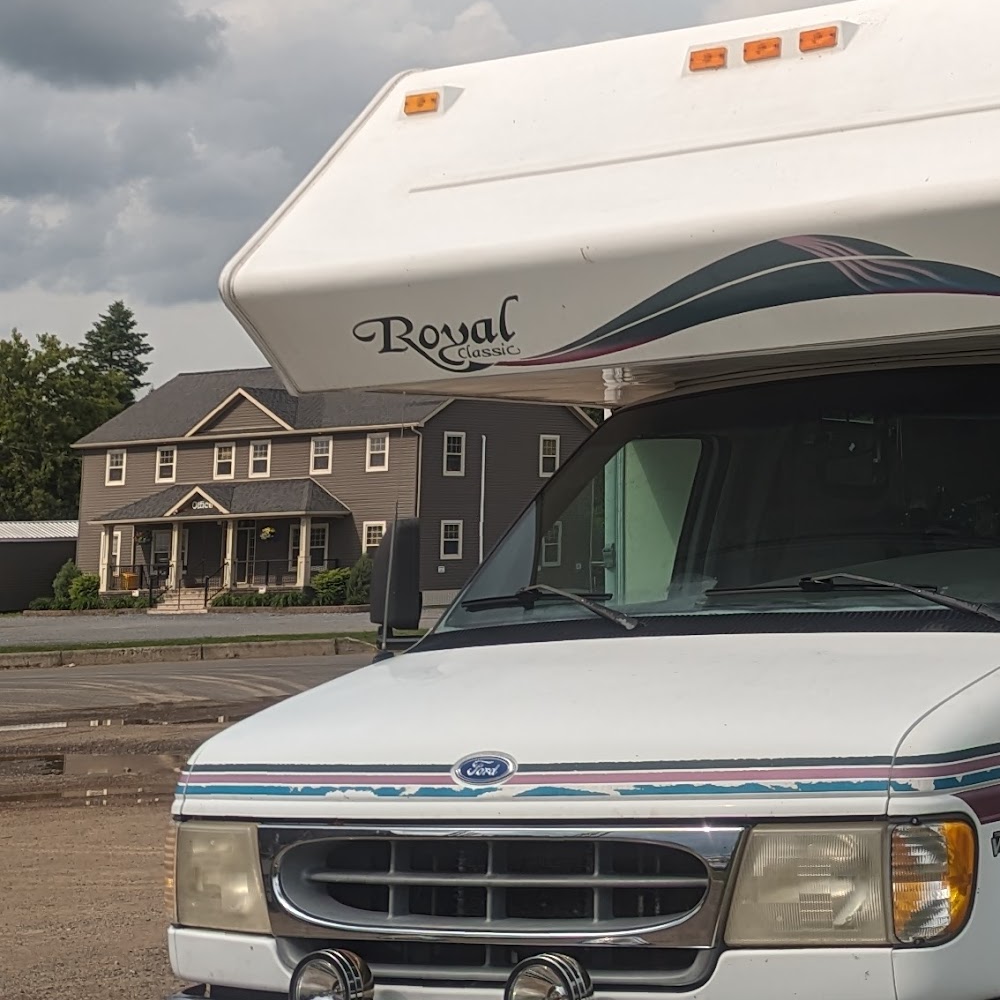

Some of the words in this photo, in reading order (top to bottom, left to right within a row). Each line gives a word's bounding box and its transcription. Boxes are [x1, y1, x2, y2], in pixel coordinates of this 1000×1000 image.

[352, 295, 519, 373] Royal
[458, 343, 521, 359] Classic
[466, 760, 501, 776] Ford
